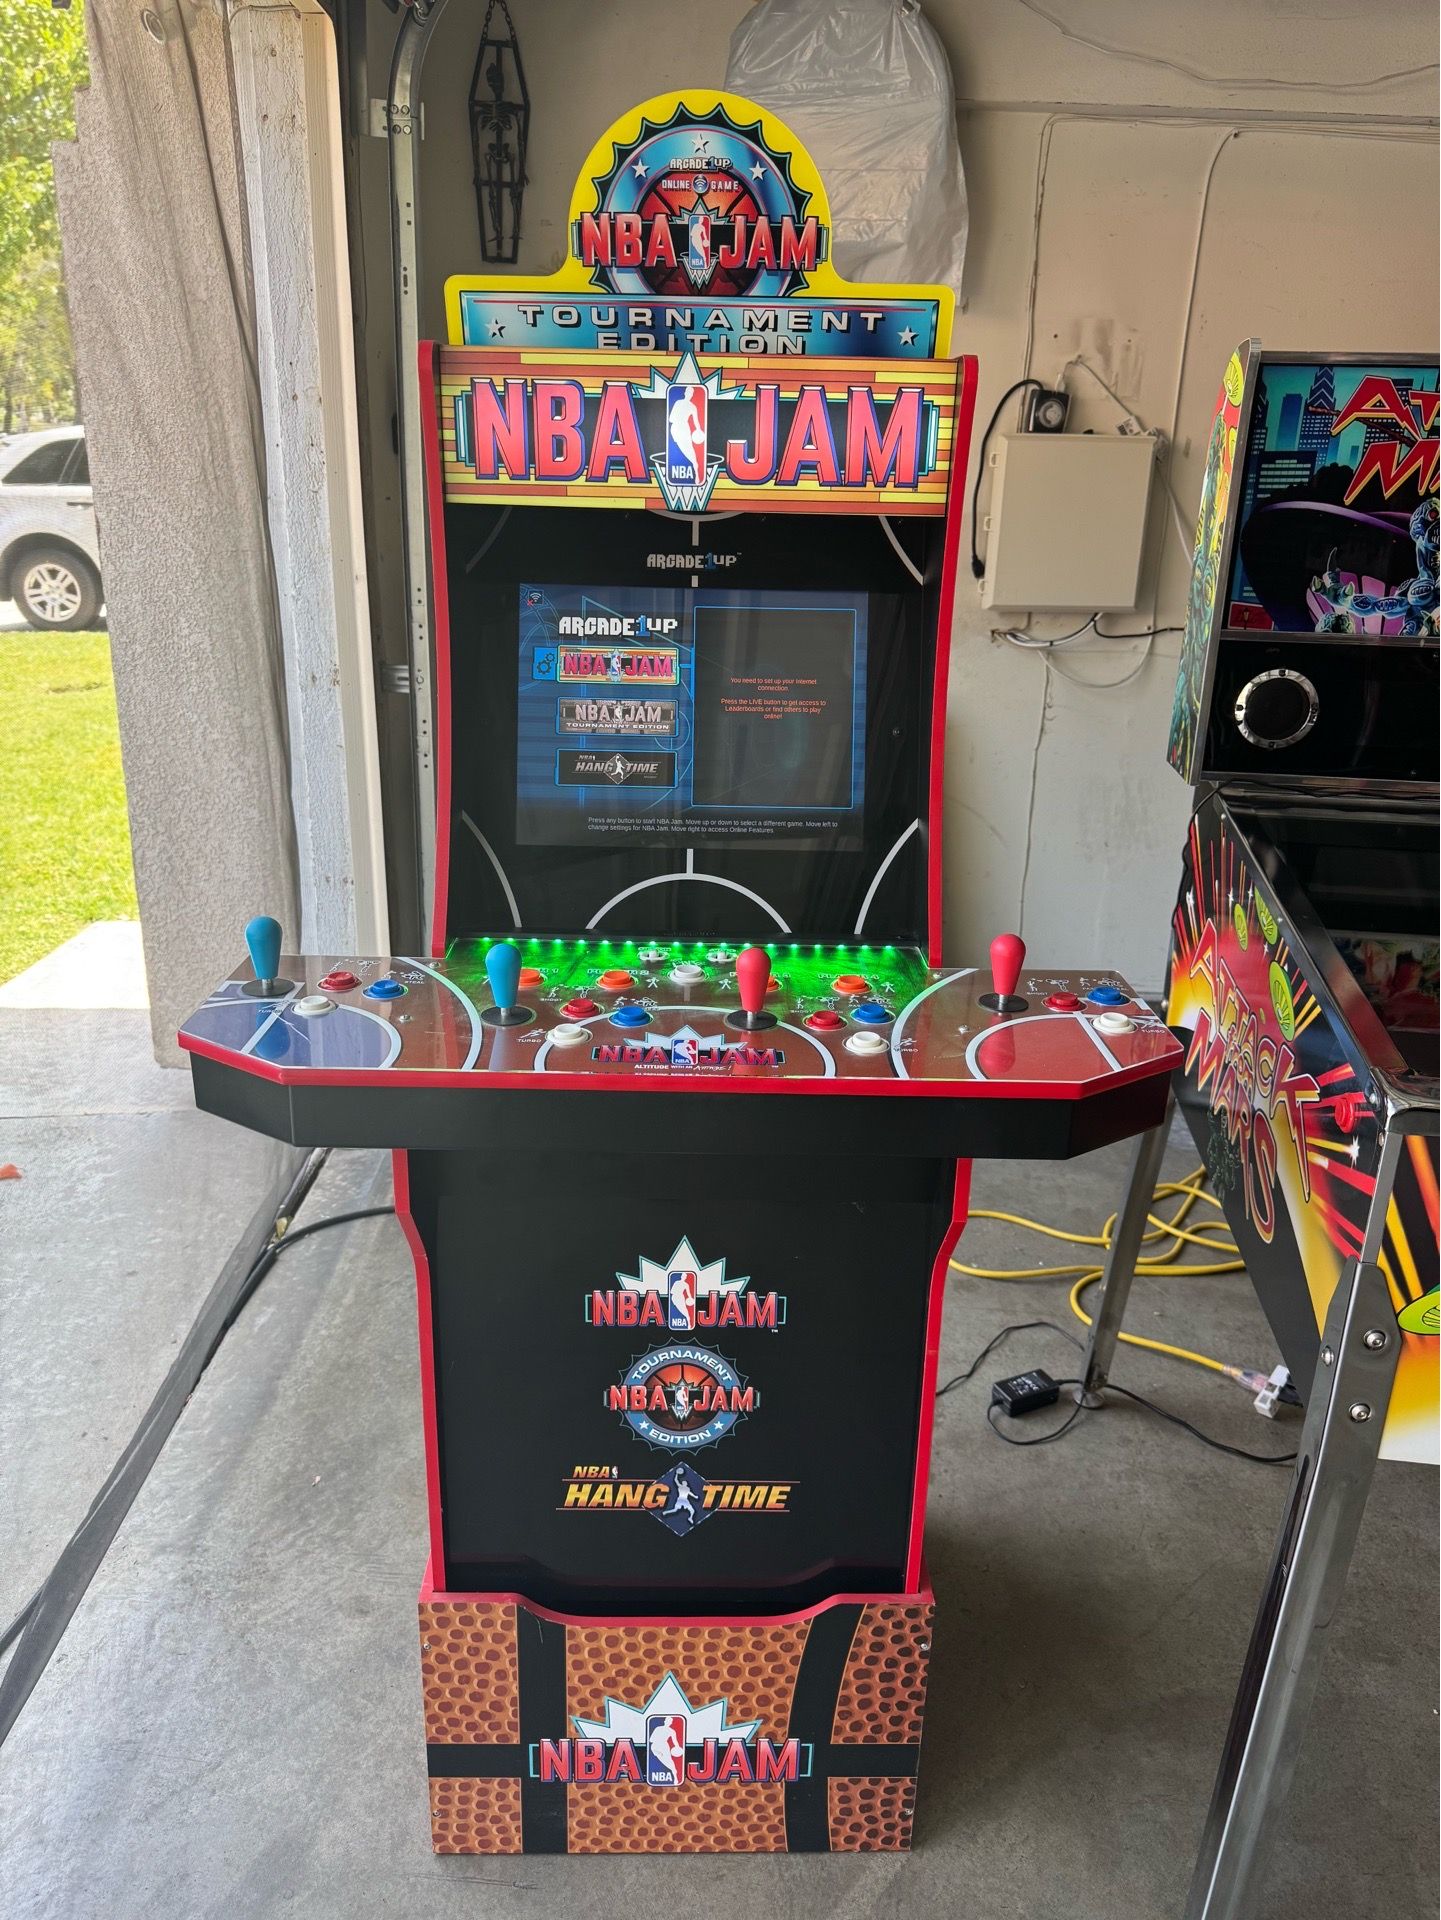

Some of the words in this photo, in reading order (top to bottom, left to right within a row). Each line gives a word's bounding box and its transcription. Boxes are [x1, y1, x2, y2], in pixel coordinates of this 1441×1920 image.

[661, 179, 691, 190] ONLINE
[710, 180, 739, 191] GAME
[580, 212, 678, 267] NBA
[719, 214, 818, 271] JAM
[691, 258, 704, 266] NBA
[517, 305, 884, 332] TOURNAMENT
[597, 332, 805, 354] EDITION
[471, 377, 653, 483] NBA
[725, 383, 923, 488] JAM
[671, 465, 694, 479] NBA
[563, 653, 608, 675] NBA
[625, 655, 673, 677] JAM
[575, 704, 610, 721] NBA
[625, 705, 662, 722] JAM
[575, 761, 614, 772] HANG
[625, 763, 659, 773] TIME
[687, 825, 700, 833] right
[599, 1045, 670, 1063] NBA
[700, 1047, 778, 1065] JAM
[1189, 917, 1320, 1203] ATTACK
[1185, 1009, 1276, 1244] MARS
[592, 1289, 667, 1327] NBA
[697, 1290, 778, 1328] JAM
[671, 1318, 687, 1326] NBA
[632, 1349, 732, 1381] TOURNAMENT
[609, 1385, 668, 1411] NBA
[693, 1385, 754, 1412] JAM
[648, 1428, 712, 1444] EDITION
[573, 1466, 610, 1478] NBA
[563, 1483, 670, 1508] HANG
[702, 1485, 790, 1509] TIME
[539, 1738, 645, 1783] NBA
[687, 1738, 801, 1783] JAM
[652, 1771, 673, 1782] NBA
